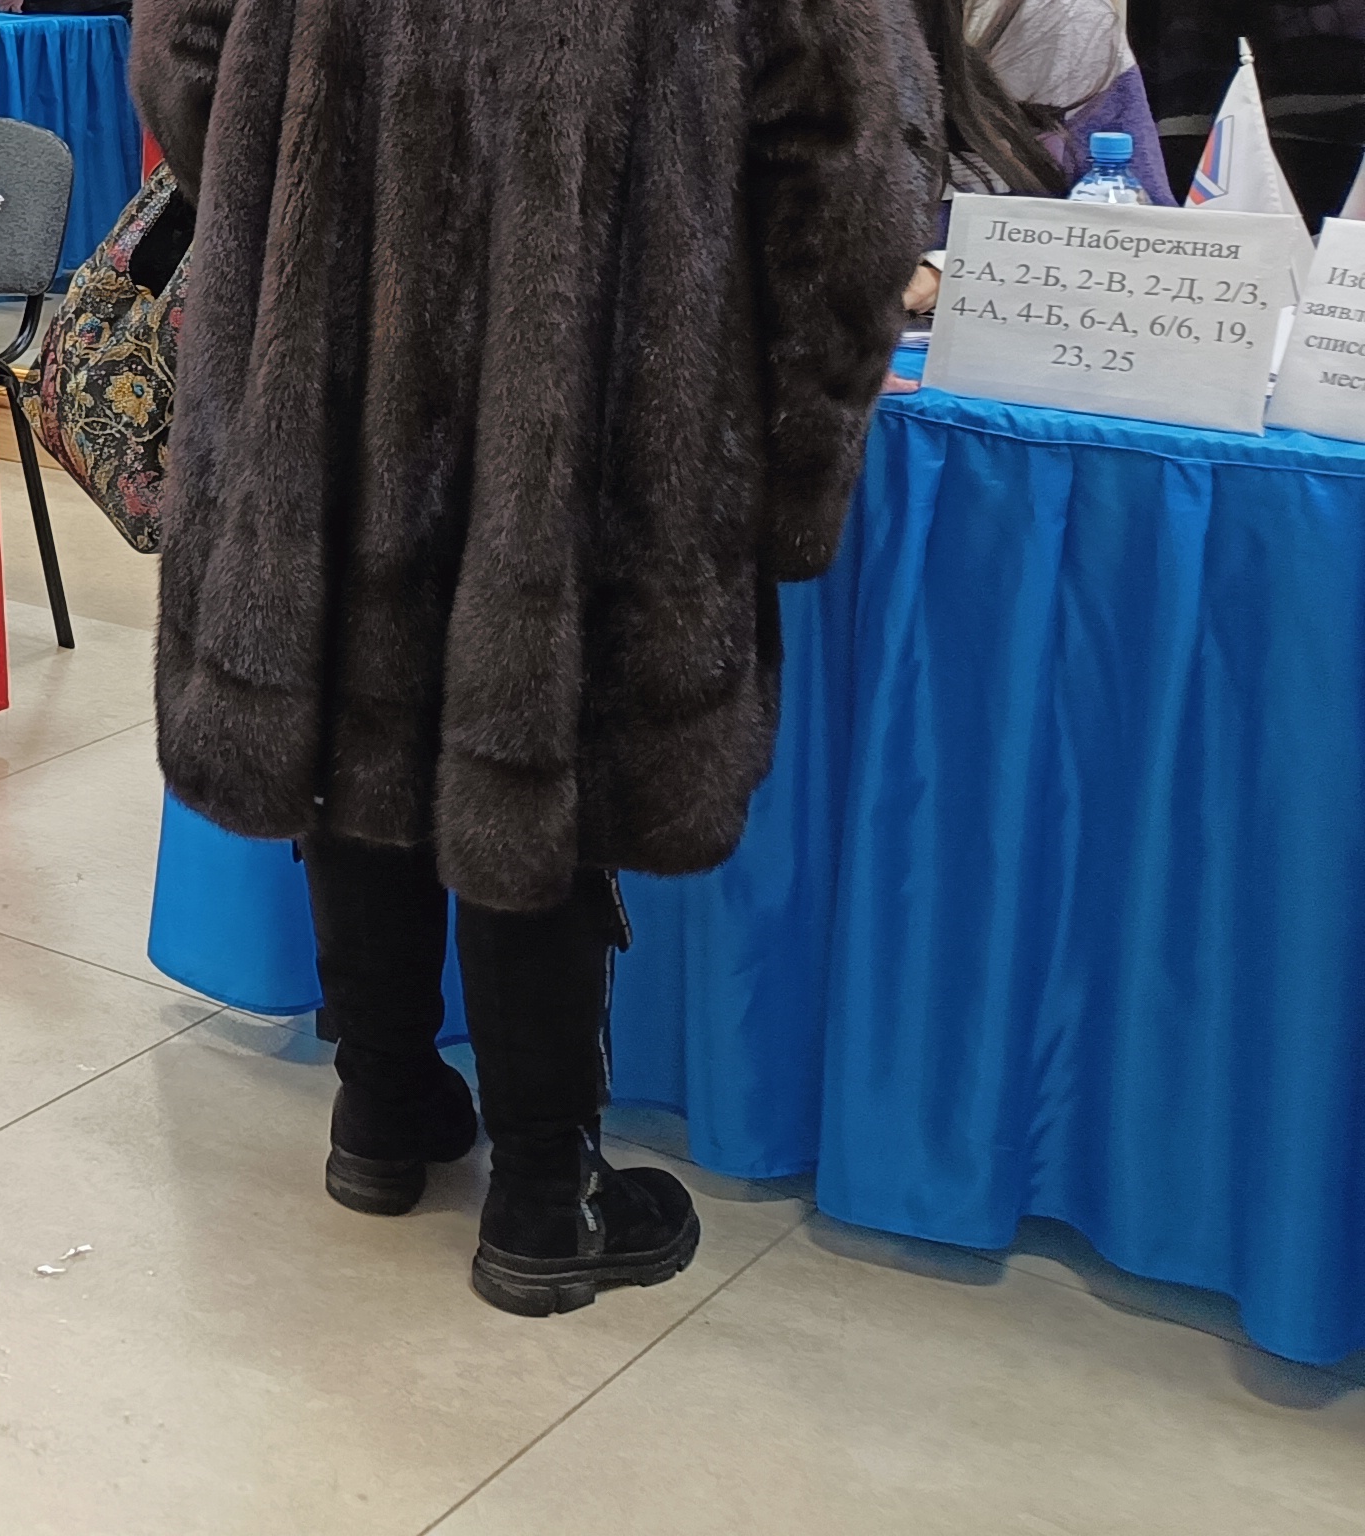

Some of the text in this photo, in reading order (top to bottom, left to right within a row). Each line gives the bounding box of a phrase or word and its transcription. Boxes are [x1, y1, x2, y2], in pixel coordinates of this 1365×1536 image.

[984, 220, 1243, 260] Лево-Набережная
[950, 258, 1268, 311] 2-А, 2-Б, 2-В, 2-Д, 2/3,
[951, 296, 1255, 350] 4-А, 4-Б, 6-А, 6/6, 19,
[1051, 344, 1136, 372] 23, 25
